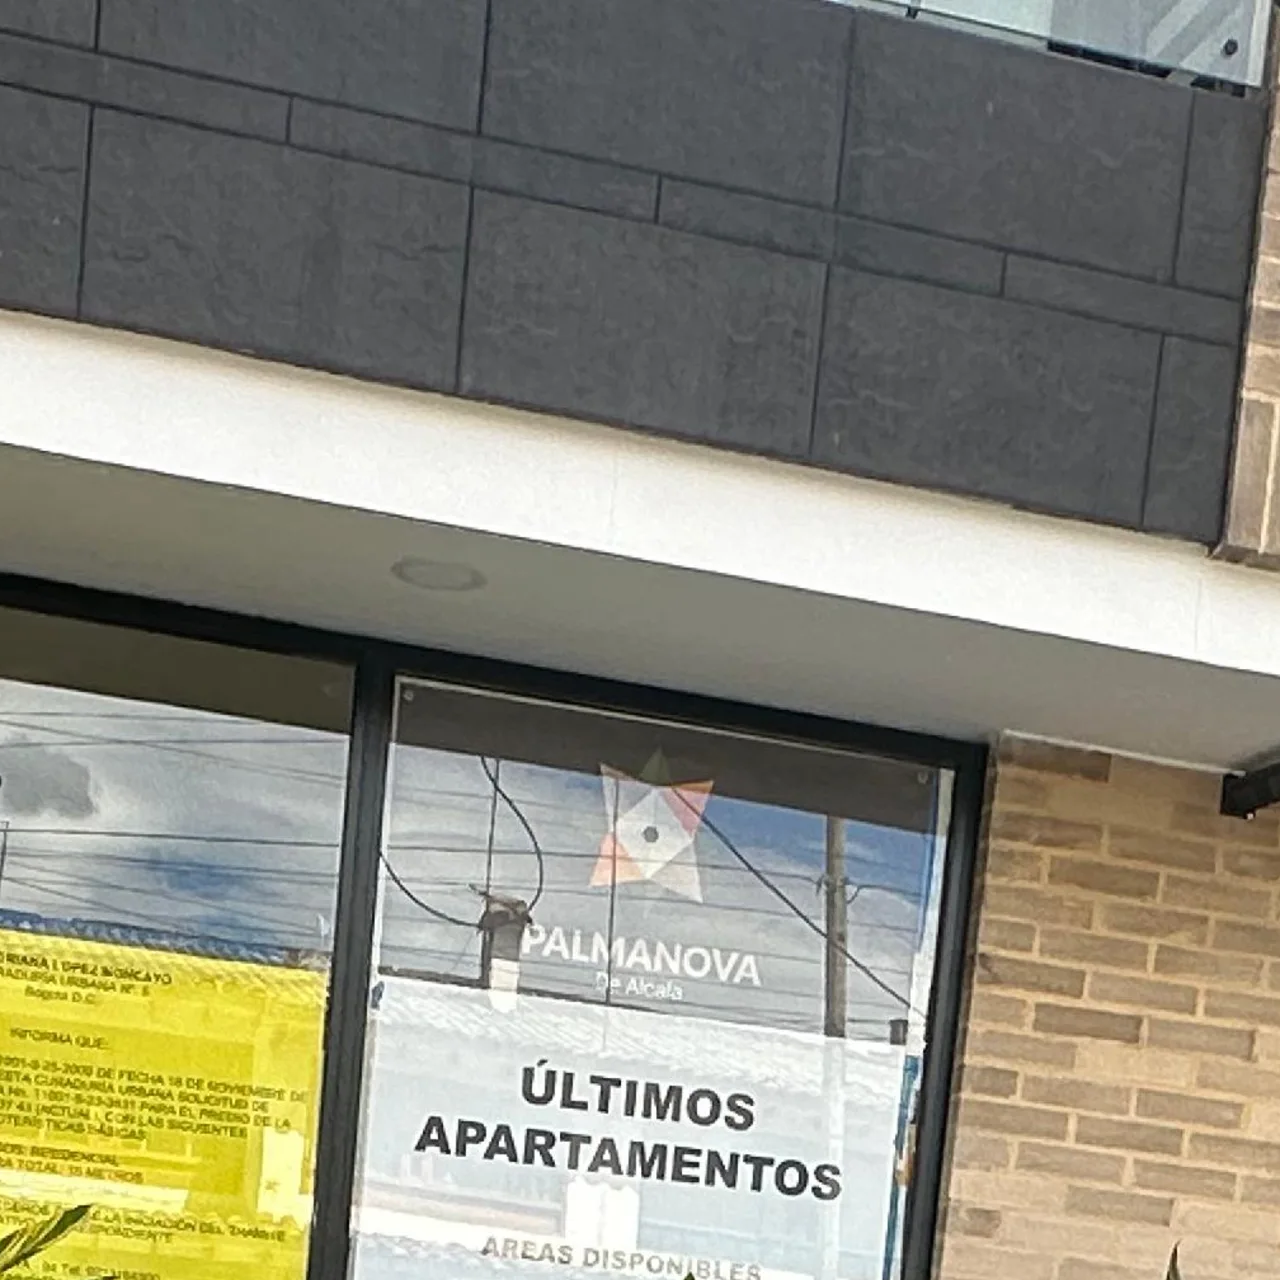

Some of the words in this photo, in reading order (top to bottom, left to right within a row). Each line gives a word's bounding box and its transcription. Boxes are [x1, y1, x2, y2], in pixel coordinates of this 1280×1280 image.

[520, 922, 762, 986] PALMANOVA
[96, 1066, 115, 1079] DE
[118, 1069, 165, 1085] FECHA
[186, 1077, 204, 1091] DE
[521, 1059, 756, 1131] ÚLTIMOS
[414, 1115, 842, 1201] APARTAMENTOS
